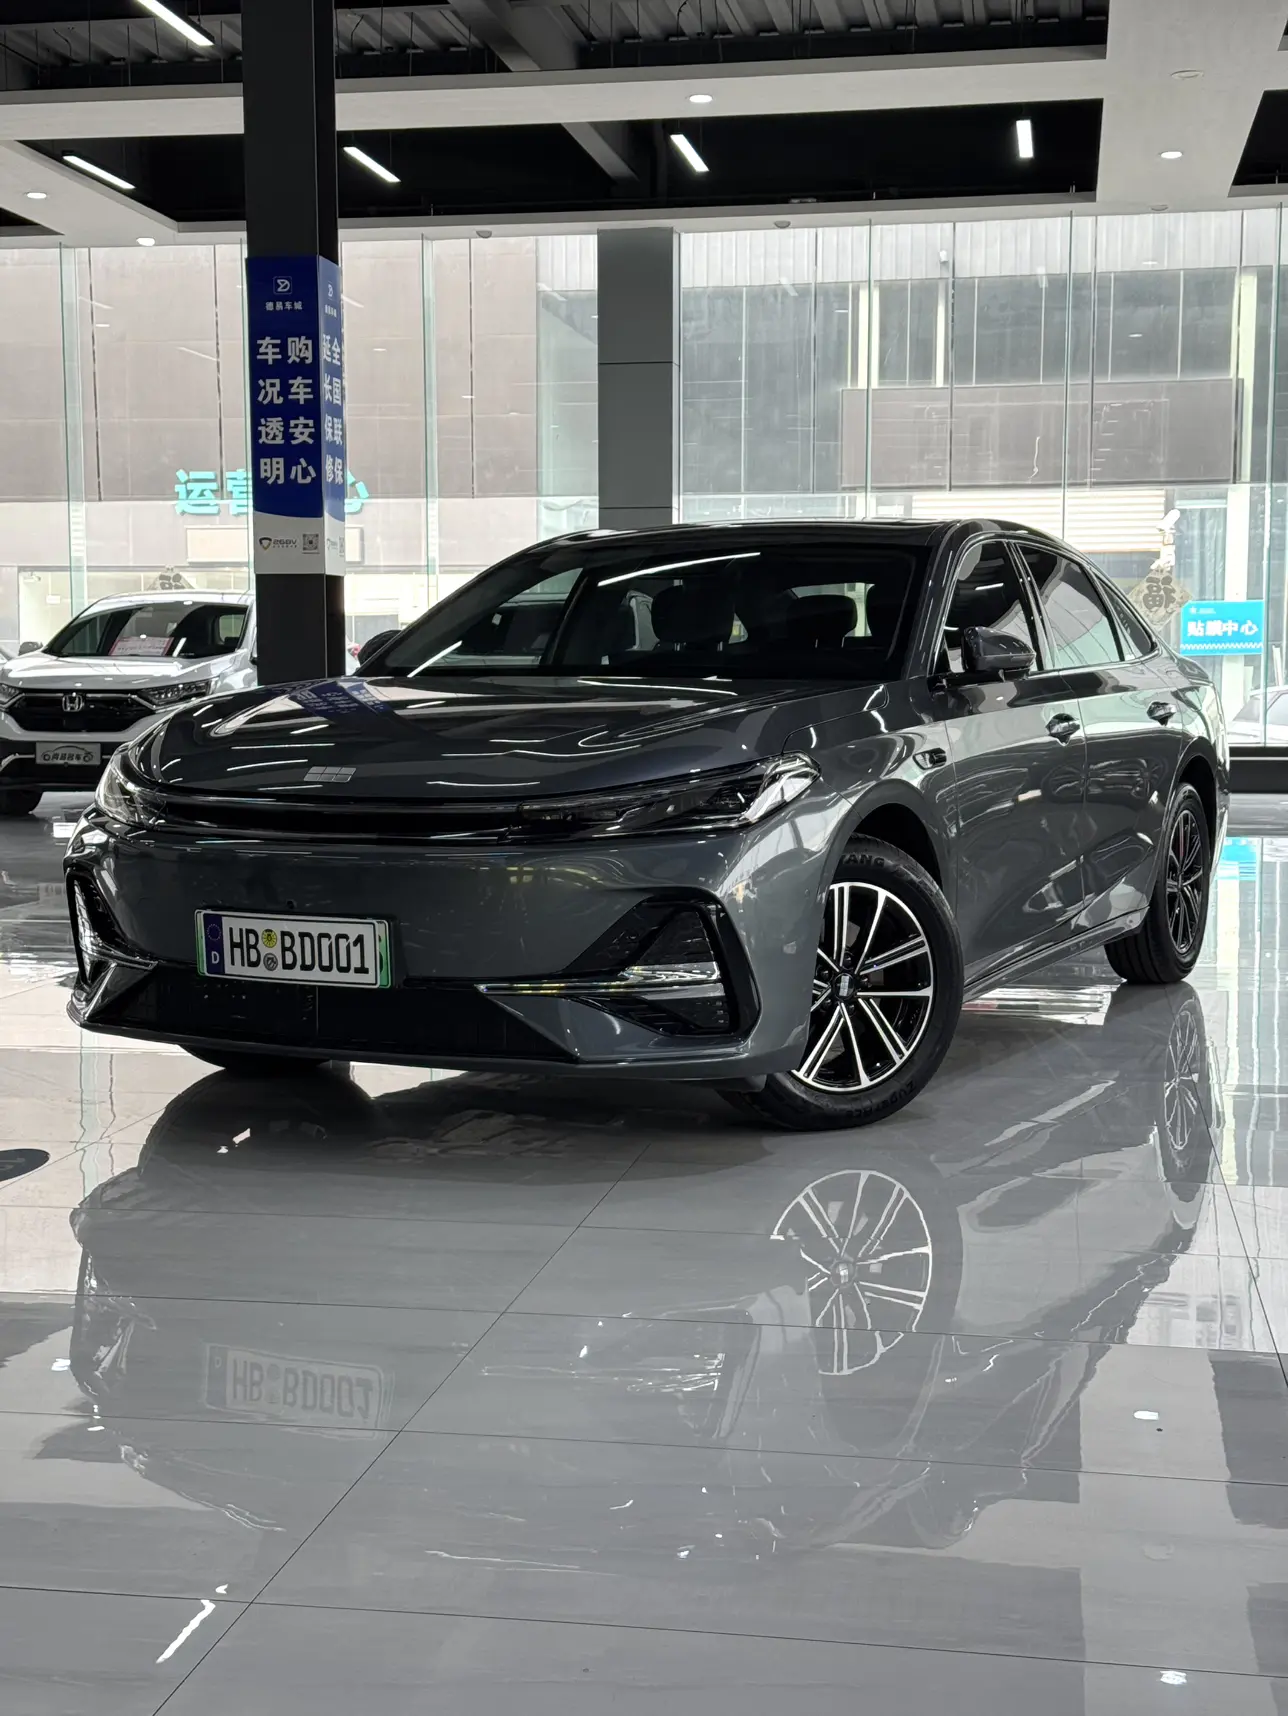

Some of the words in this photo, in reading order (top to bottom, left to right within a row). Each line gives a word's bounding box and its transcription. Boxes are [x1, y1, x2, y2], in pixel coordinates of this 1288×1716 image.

[256, 336, 285, 484] 车况透明
[287, 336, 316, 484] 购车安心
[211, 951, 220, 964] D
[229, 926, 262, 968] HB
[280, 930, 370, 975] BD001
